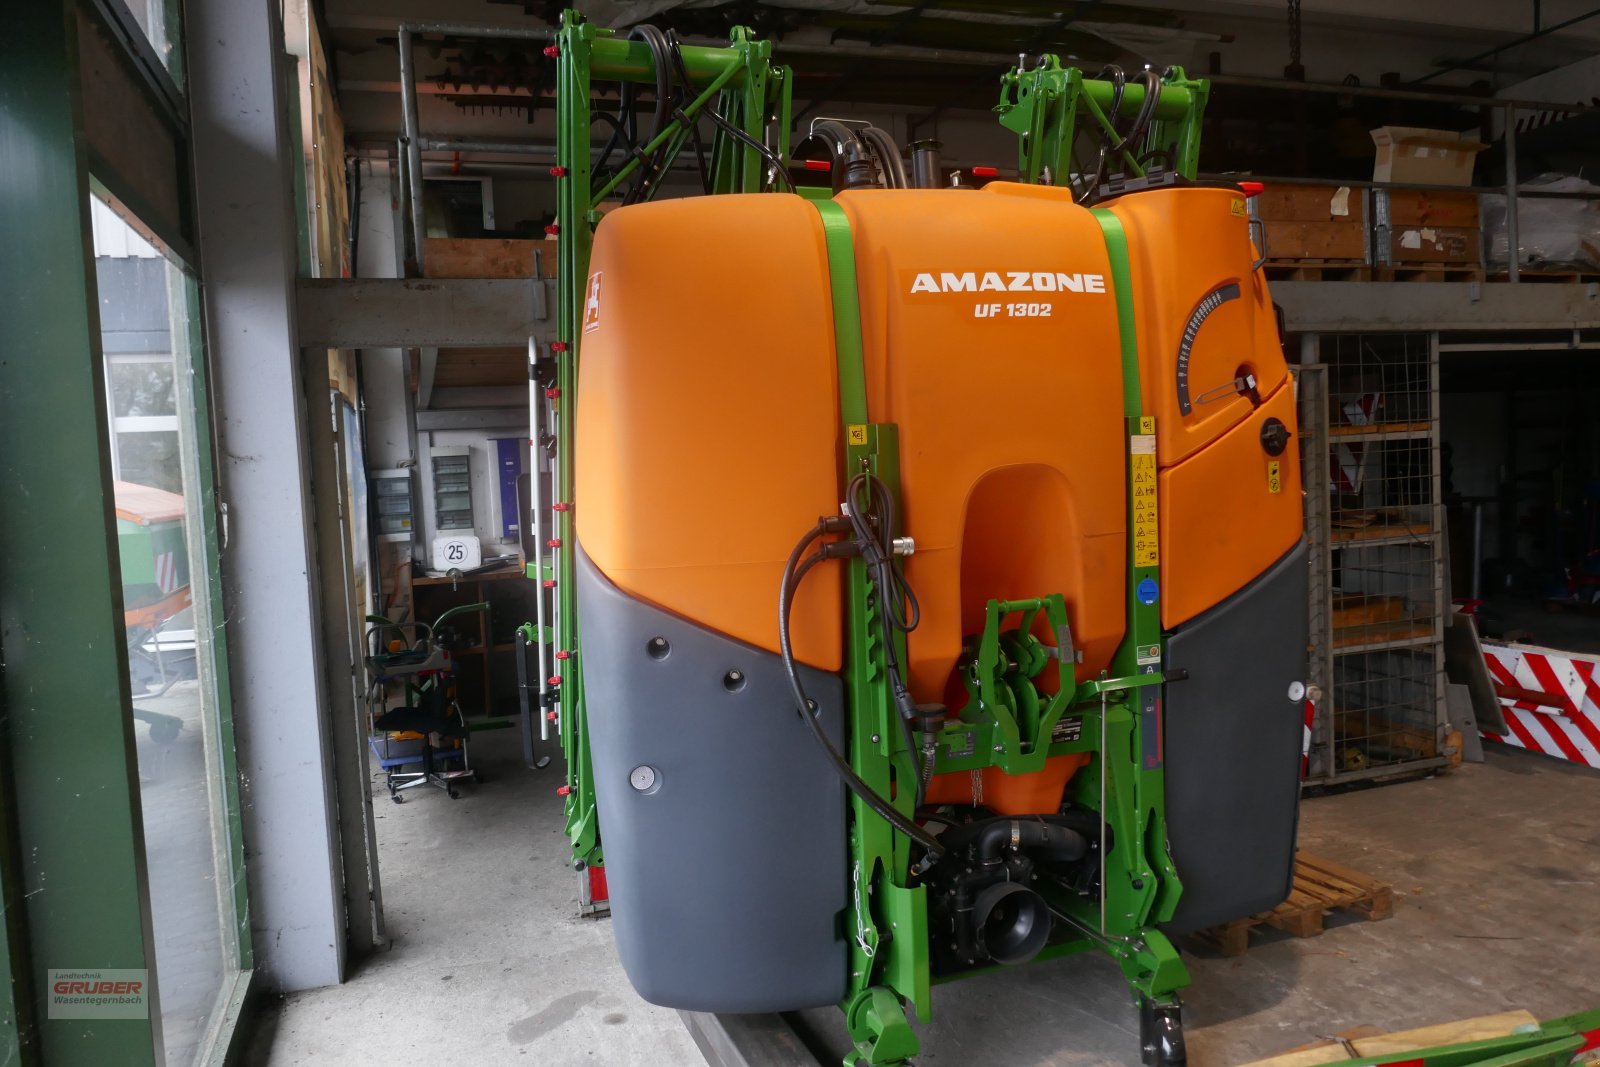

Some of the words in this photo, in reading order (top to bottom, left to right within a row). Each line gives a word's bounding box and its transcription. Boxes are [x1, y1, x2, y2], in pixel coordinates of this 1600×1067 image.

[910, 272, 1106, 293] AMAZONE
[974, 303, 1001, 317] UF
[1006, 303, 1052, 317] 1302
[448, 545, 463, 560] 25
